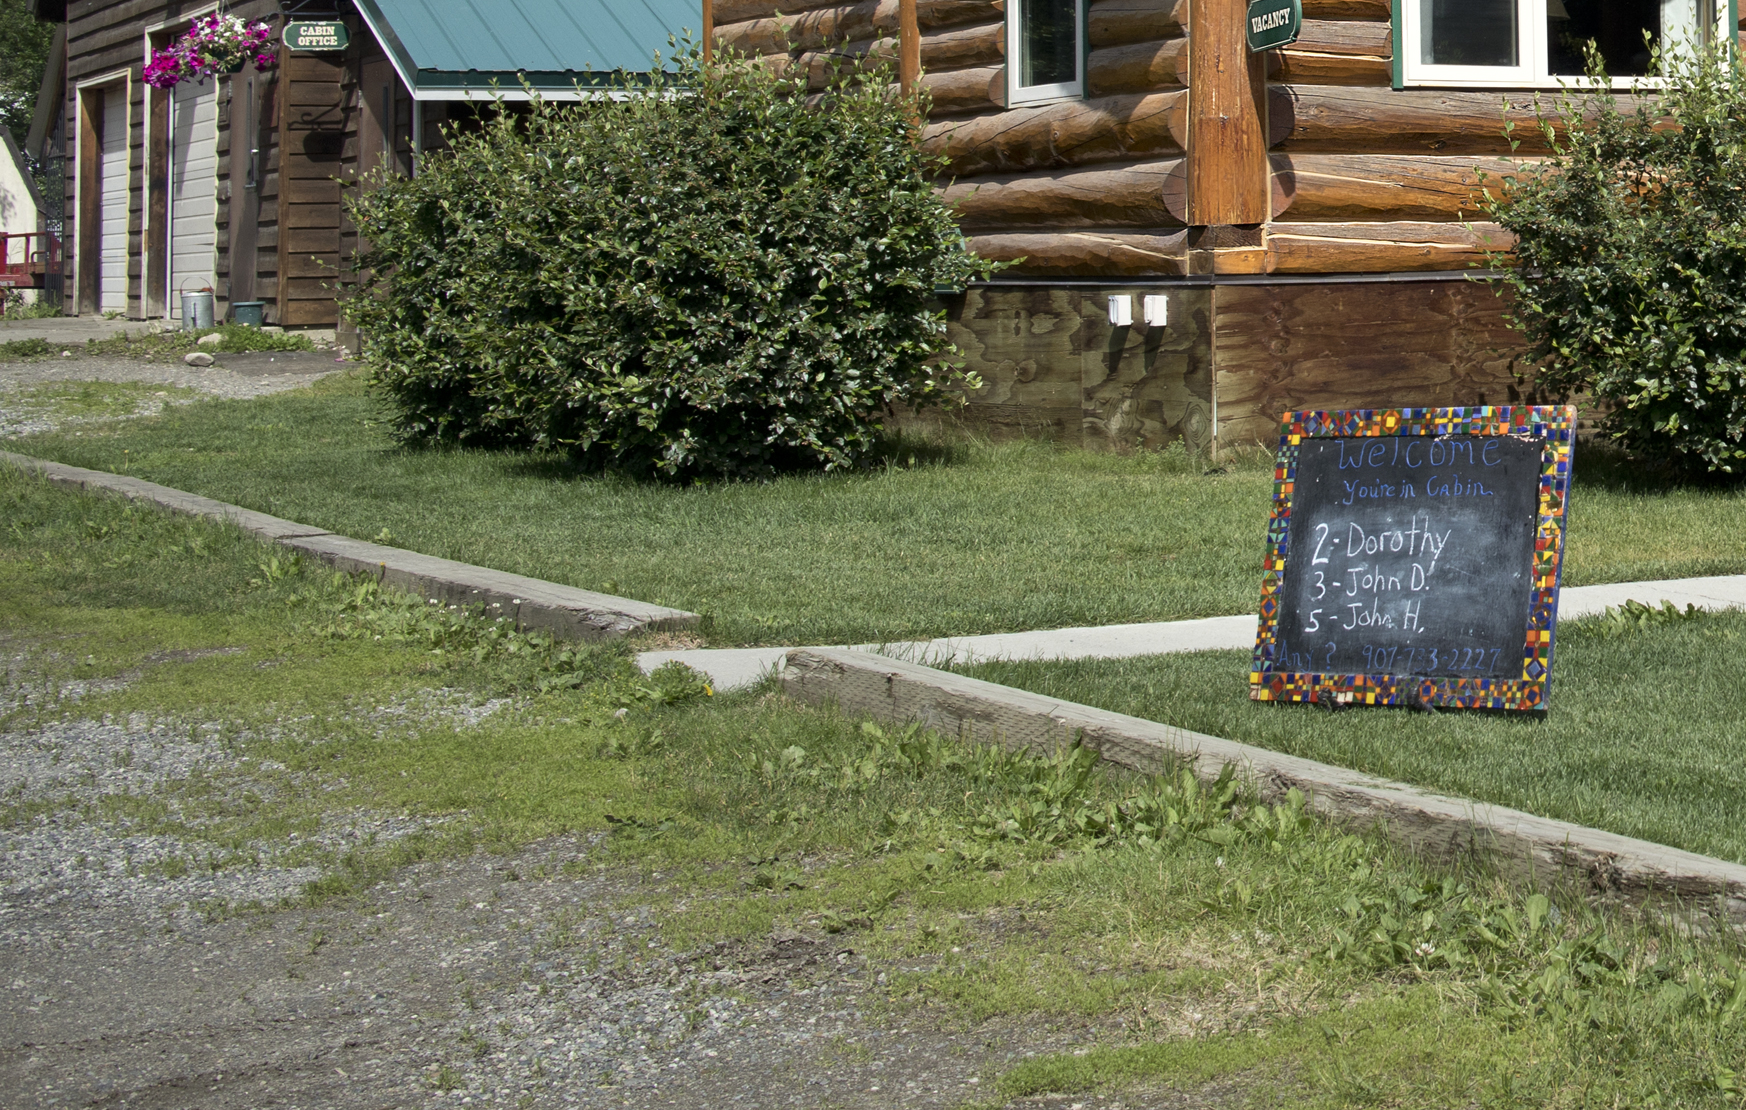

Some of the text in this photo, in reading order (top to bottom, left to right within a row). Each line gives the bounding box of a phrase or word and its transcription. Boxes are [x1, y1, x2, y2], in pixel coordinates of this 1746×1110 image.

[300, 26, 335, 36] CABIN
[1251, 7, 1291, 34] VACANCY
[297, 36, 338, 46] OFFICE
[1399, 479, 1416, 499] in
[1346, 515, 1452, 576] Dorothy
[1346, 565, 1401, 597] John
[1343, 597, 1392, 630] John
